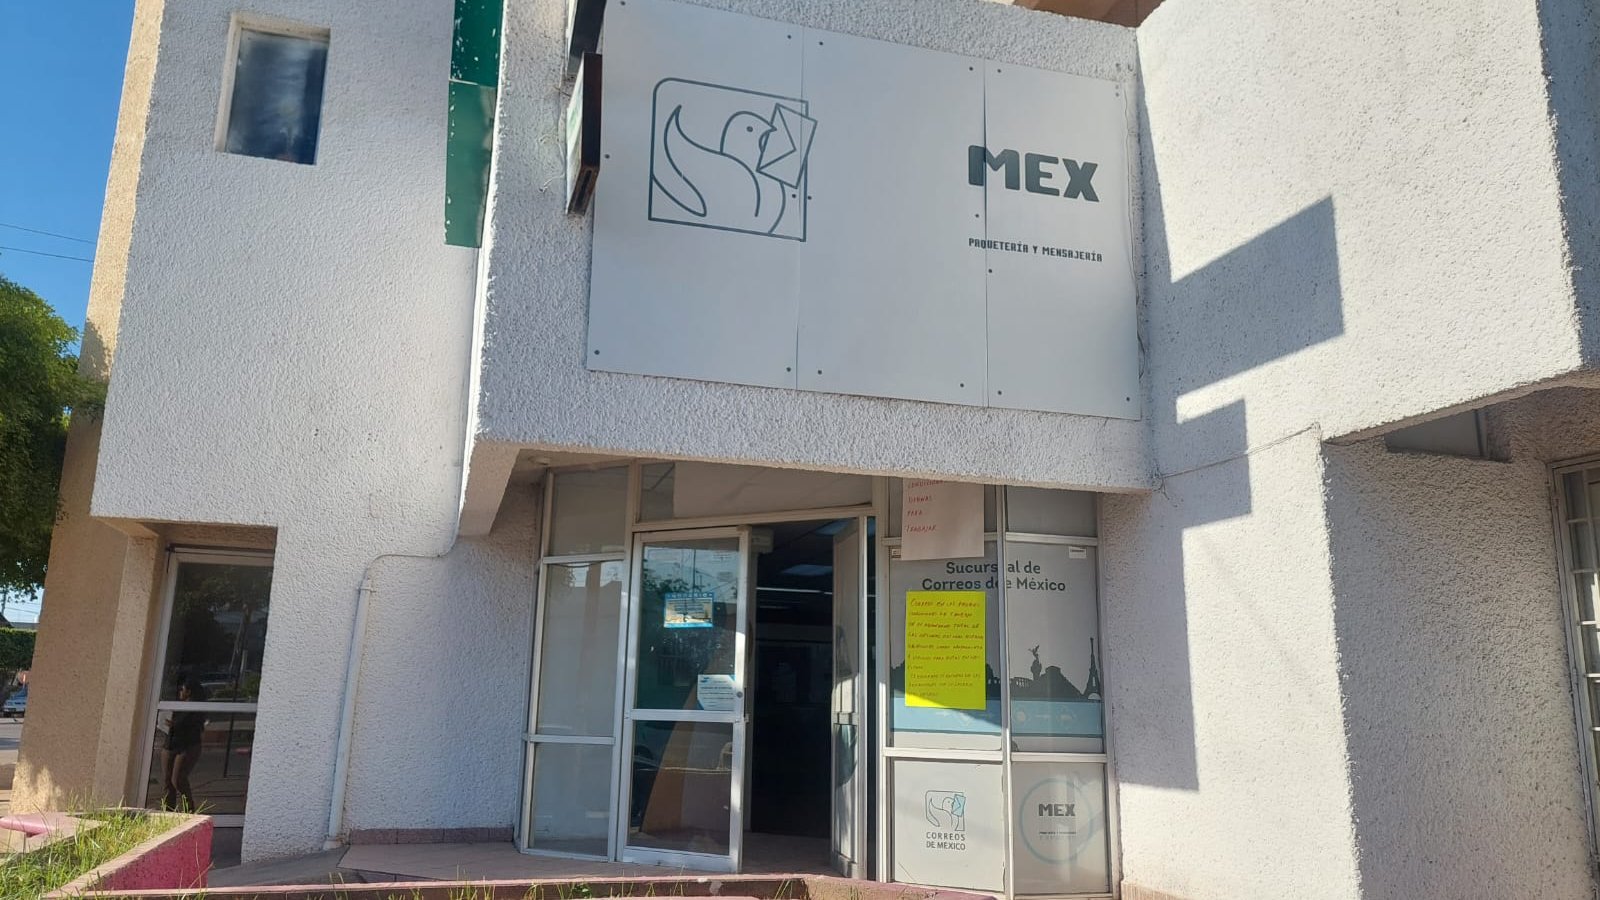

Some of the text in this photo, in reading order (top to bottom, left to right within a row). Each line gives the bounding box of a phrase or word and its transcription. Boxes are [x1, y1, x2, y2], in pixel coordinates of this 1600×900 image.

[968, 145, 1099, 202] MEX
[968, 237, 1103, 262] PAQUETERÍA Y MENSAJERÍA
[1023, 561, 1041, 574] de
[922, 578, 981, 591] Correos
[1016, 576, 1066, 591] México
[1038, 804, 1076, 817] MEX
[926, 831, 966, 841] CORREOS
[926, 840, 936, 849] DE
